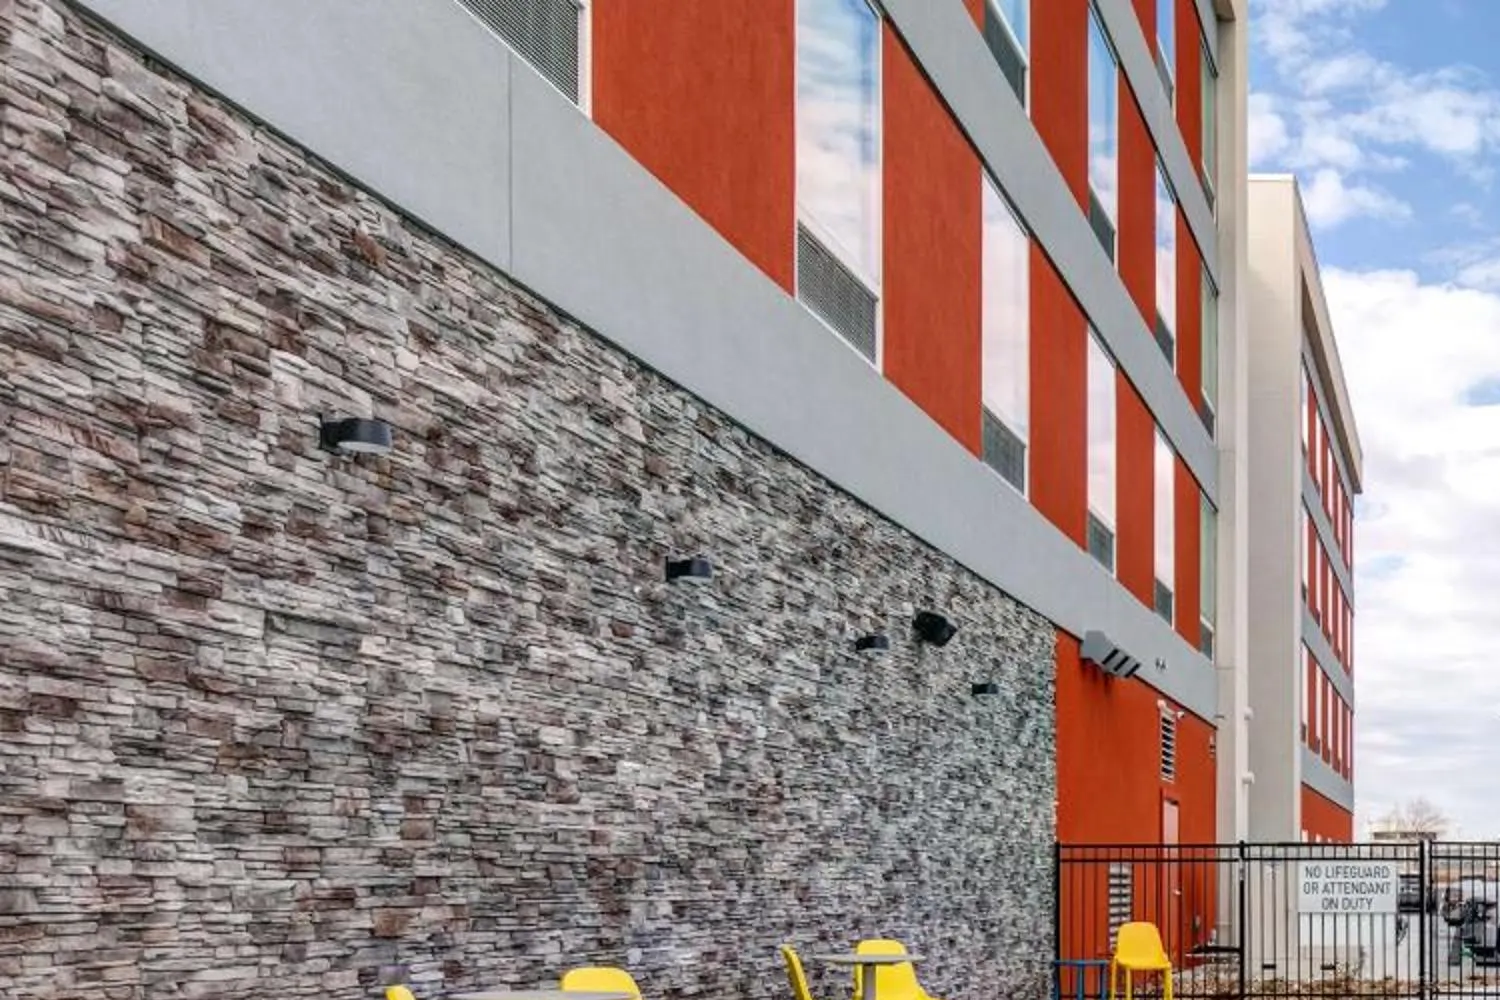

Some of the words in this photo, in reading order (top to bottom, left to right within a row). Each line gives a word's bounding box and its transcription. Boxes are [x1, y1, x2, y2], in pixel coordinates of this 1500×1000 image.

[1305, 865, 1322, 879] NO
[1325, 865, 1391, 879] LIFEGUARD
[1303, 881, 1319, 895] OR
[1322, 881, 1391, 895] ATTENDANT
[1321, 897, 1339, 910] ON
[1341, 897, 1373, 910] DUTY
